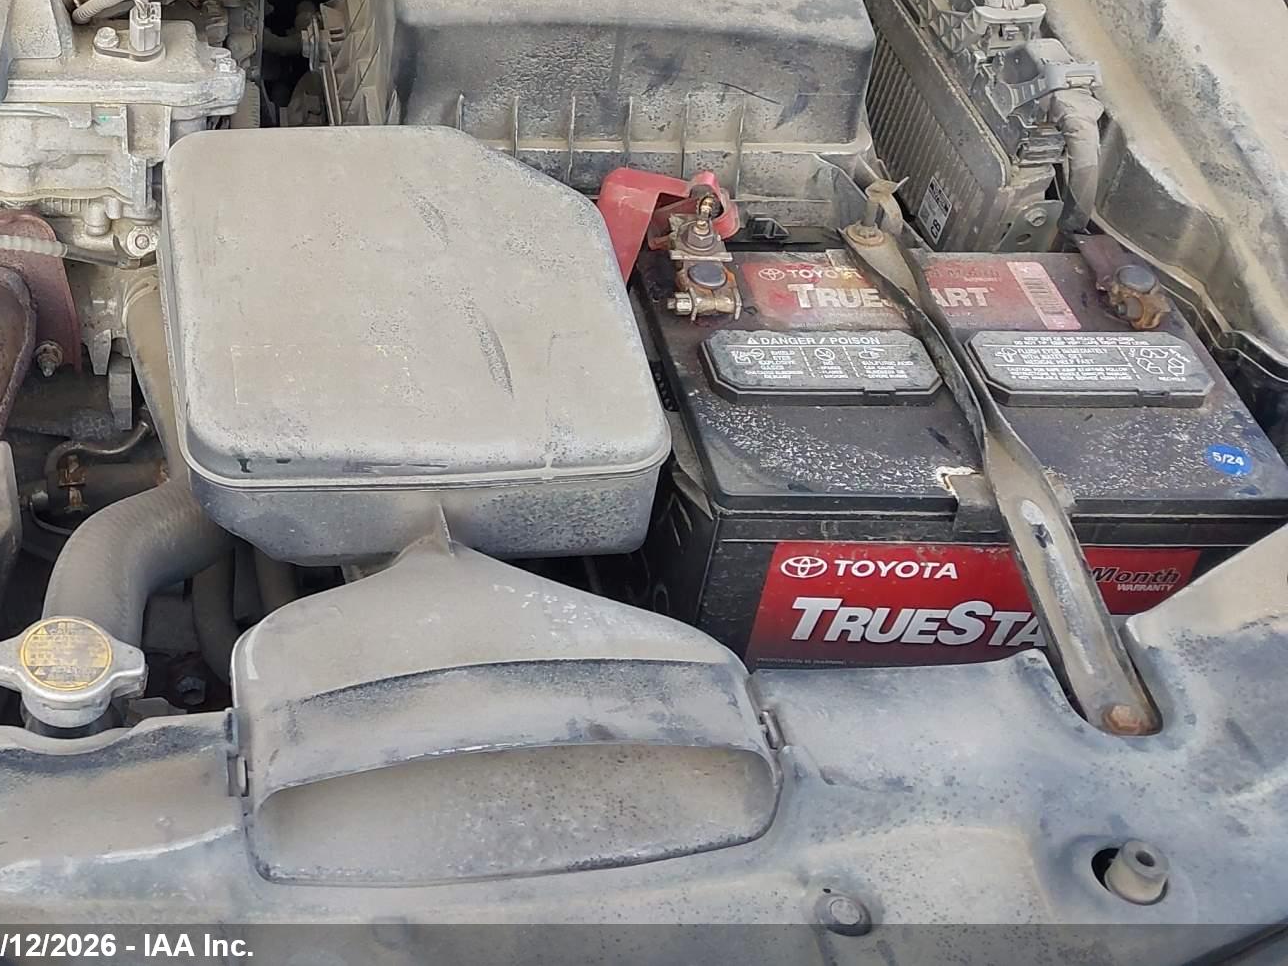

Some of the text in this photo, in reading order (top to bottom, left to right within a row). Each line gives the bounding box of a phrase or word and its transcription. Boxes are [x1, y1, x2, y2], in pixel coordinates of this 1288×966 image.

[760, 337, 817, 345] DANGER
[829, 337, 881, 345] POISON
[1212, 451, 1245, 466] 5/24
[834, 559, 958, 580] TOYOTA
[1092, 566, 1182, 583] Month
[1117, 583, 1174, 592] WARRANTY
